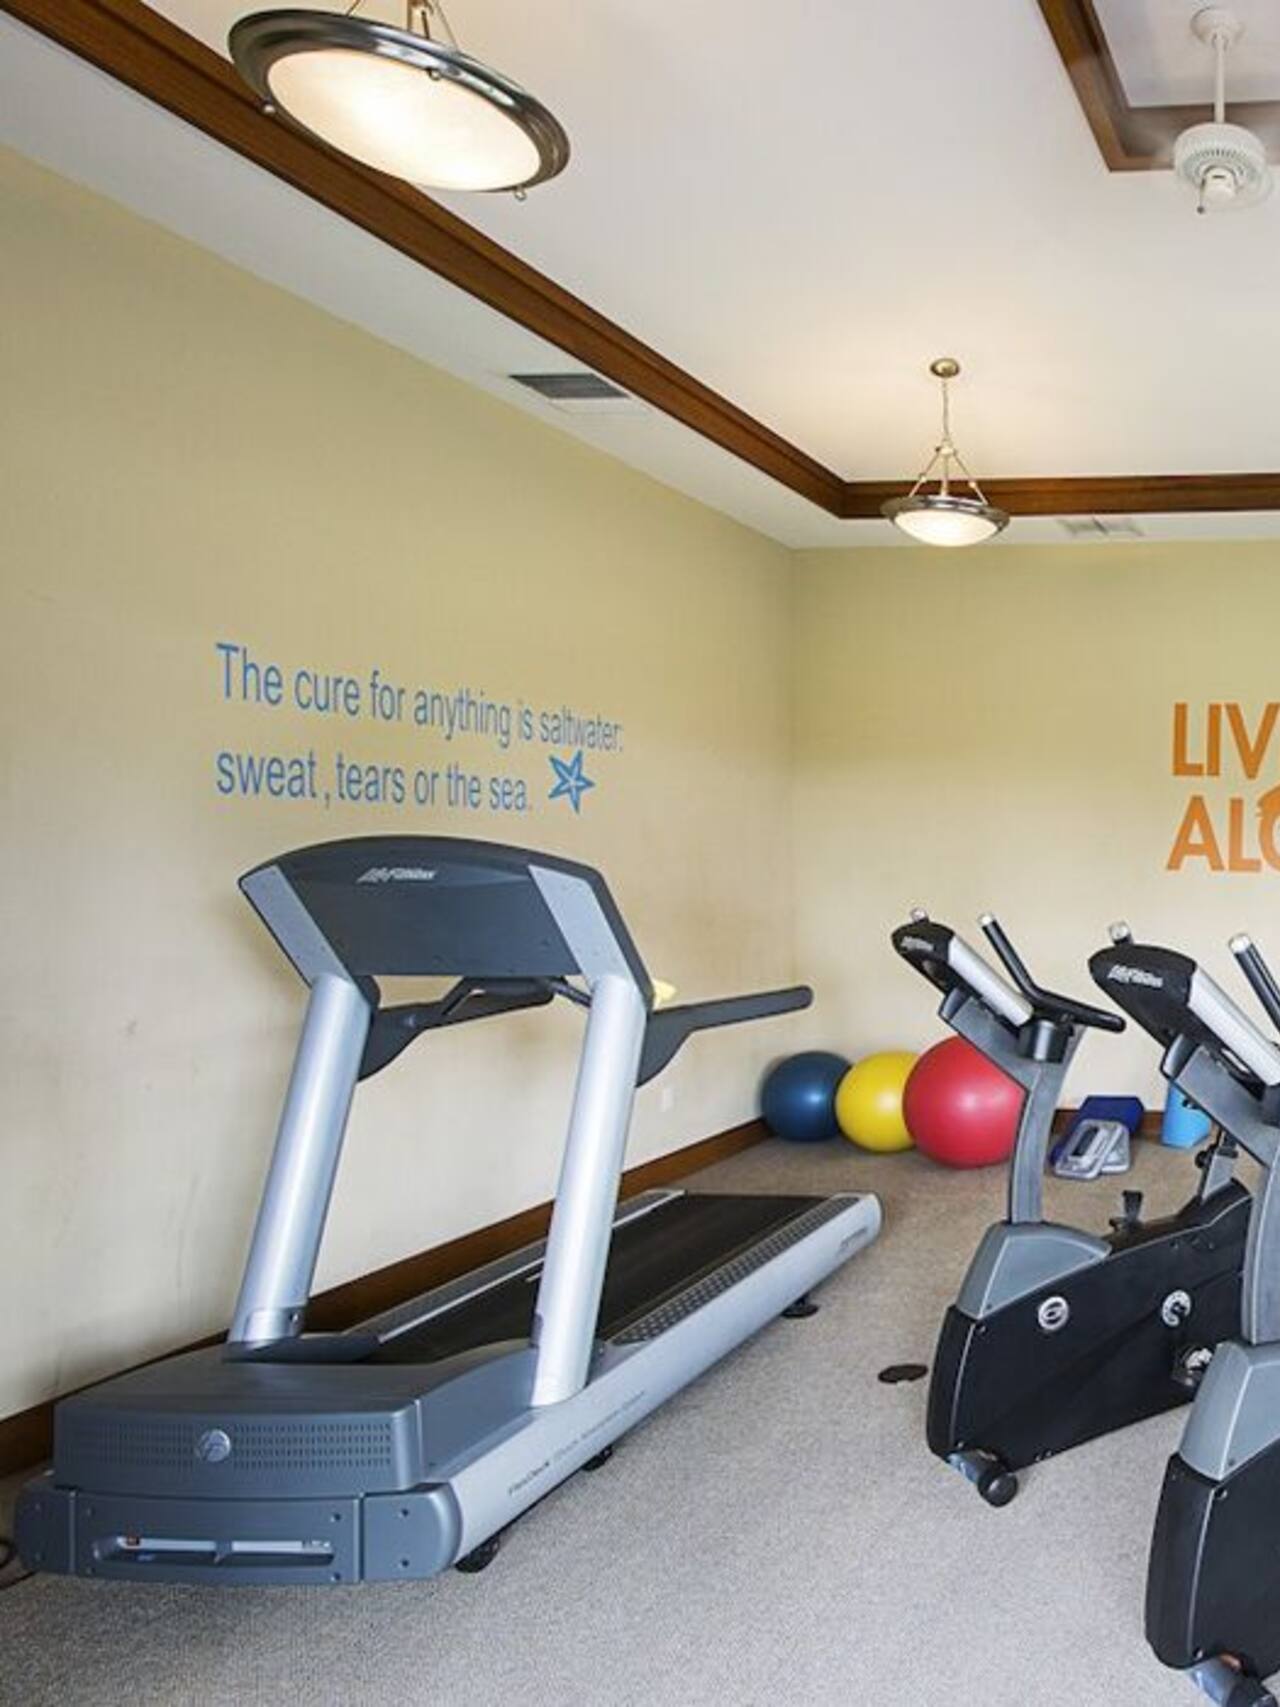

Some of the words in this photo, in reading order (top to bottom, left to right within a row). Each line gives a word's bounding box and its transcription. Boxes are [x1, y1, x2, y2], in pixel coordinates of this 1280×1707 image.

[216, 642, 283, 706] The
[294, 670, 360, 716] cure
[370, 669, 406, 721] for
[414, 688, 511, 749] anything
[519, 699, 533, 741] is
[336, 753, 405, 803] tears
[415, 770, 439, 805] or
[447, 761, 481, 809] the
